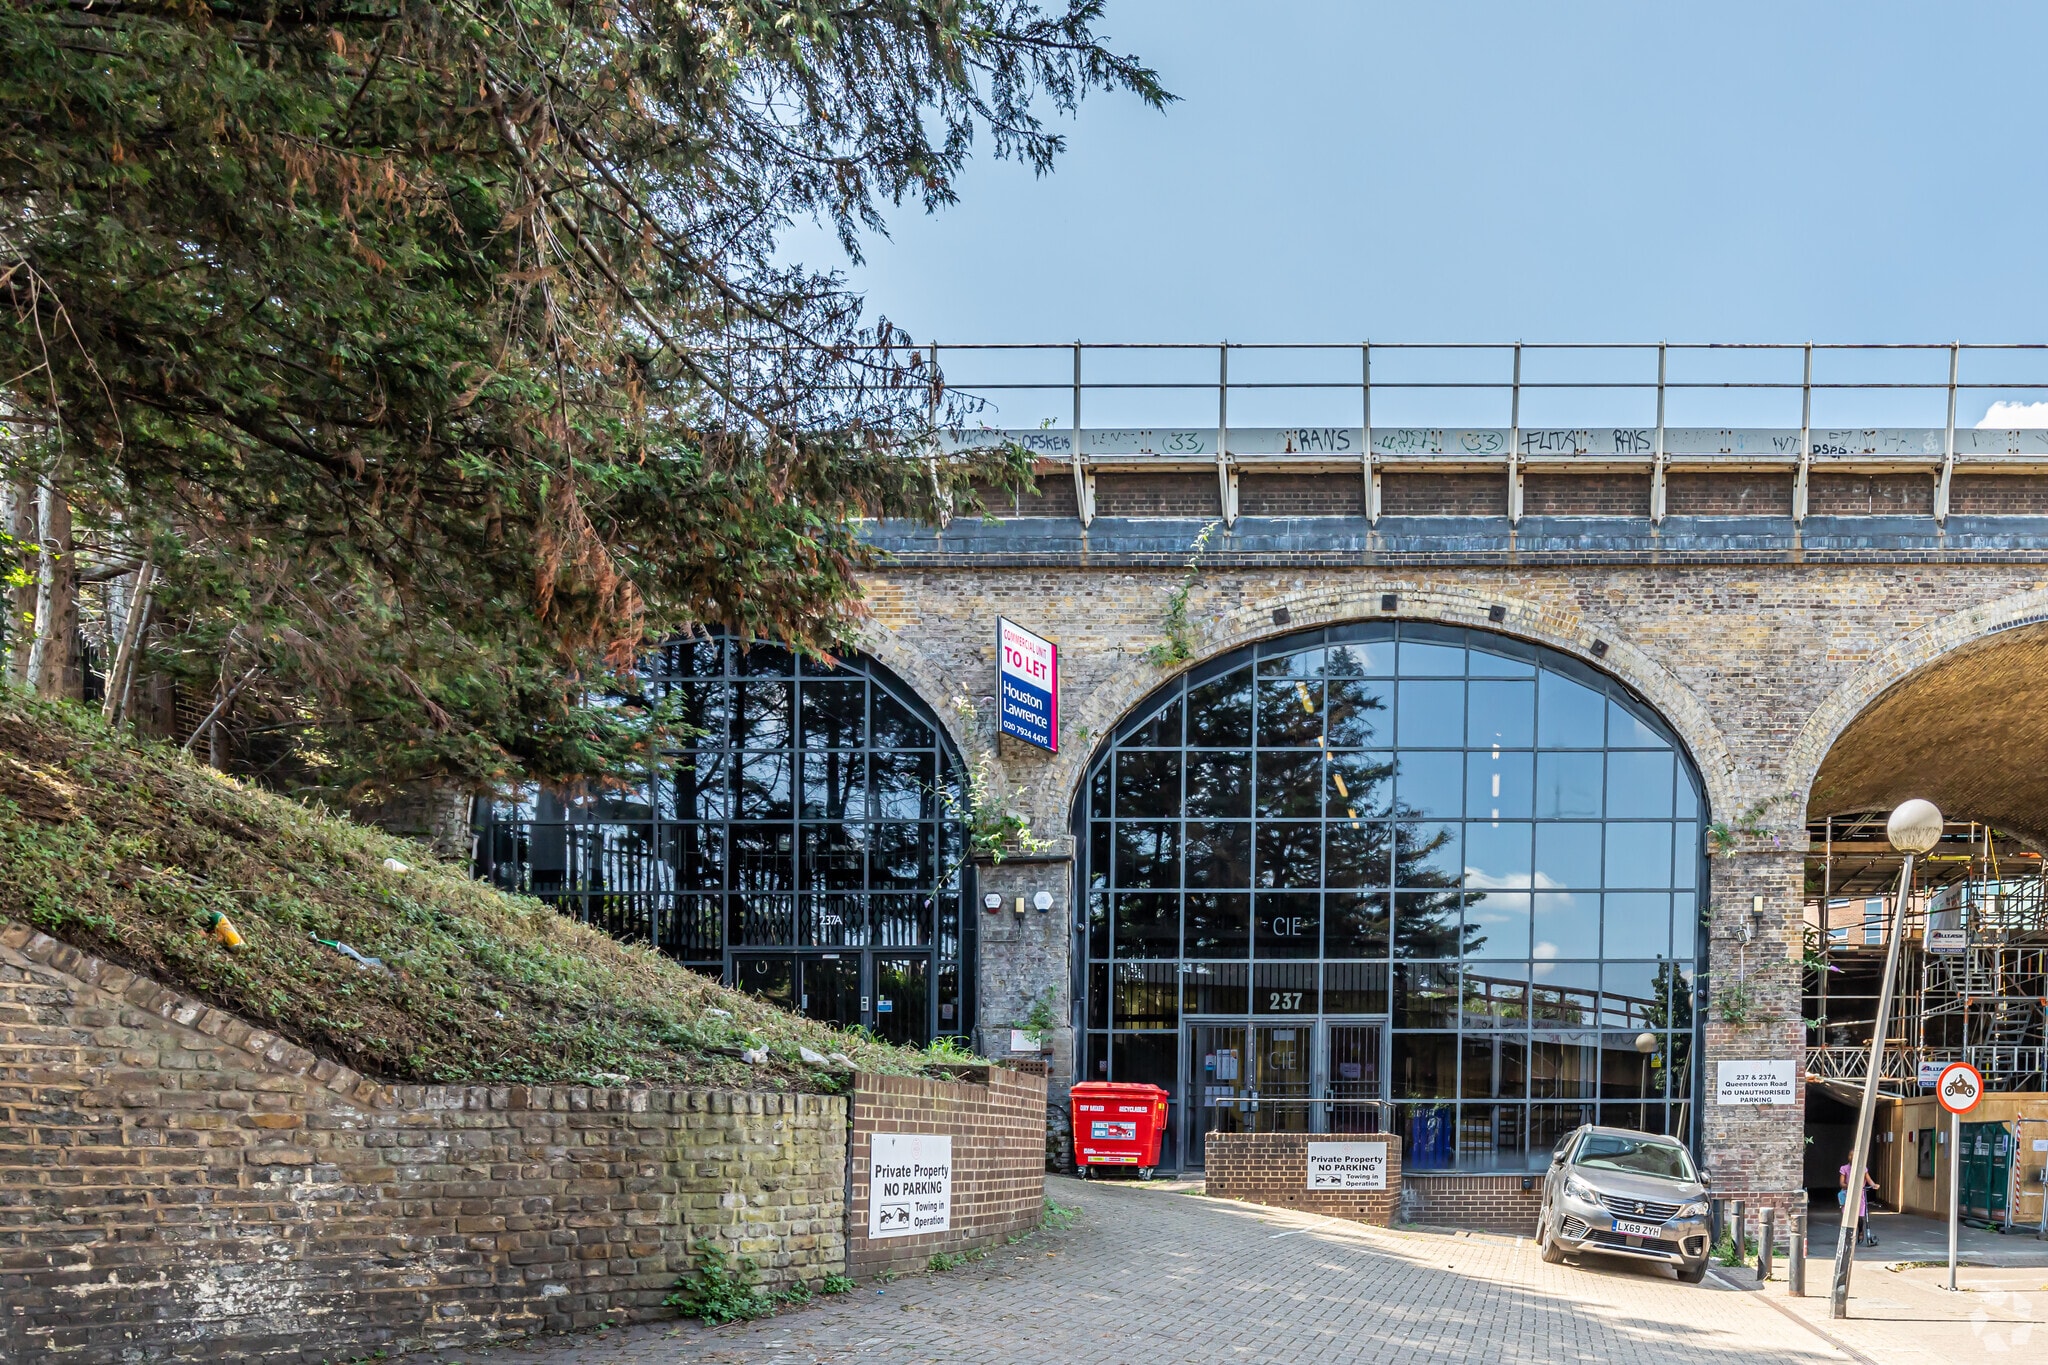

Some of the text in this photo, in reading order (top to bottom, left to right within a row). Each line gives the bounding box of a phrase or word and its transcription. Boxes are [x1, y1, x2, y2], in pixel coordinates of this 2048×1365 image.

[1003, 628, 1047, 660] COMMERCIAL UNIT
[1004, 645, 1047, 681] TO LET
[1003, 680, 1043, 711] Houston
[1003, 697, 1048, 729] Lawrence
[1003, 720, 1048, 744] 020 7924 4476
[819, 915, 843, 925] 237A
[1272, 917, 1302, 936] CIE
[1269, 993, 1303, 1010] 237
[1269, 1051, 1297, 1071] CIE
[1344, 1156, 1383, 1164] Property
[875, 1164, 949, 1180] Private Property
[884, 1181, 942, 1196] NO PARKING
[915, 1200, 945, 1213] Towing in
[914, 1216, 945, 1228] Operation
[1618, 1223, 1659, 1236] LX69 ZYH
